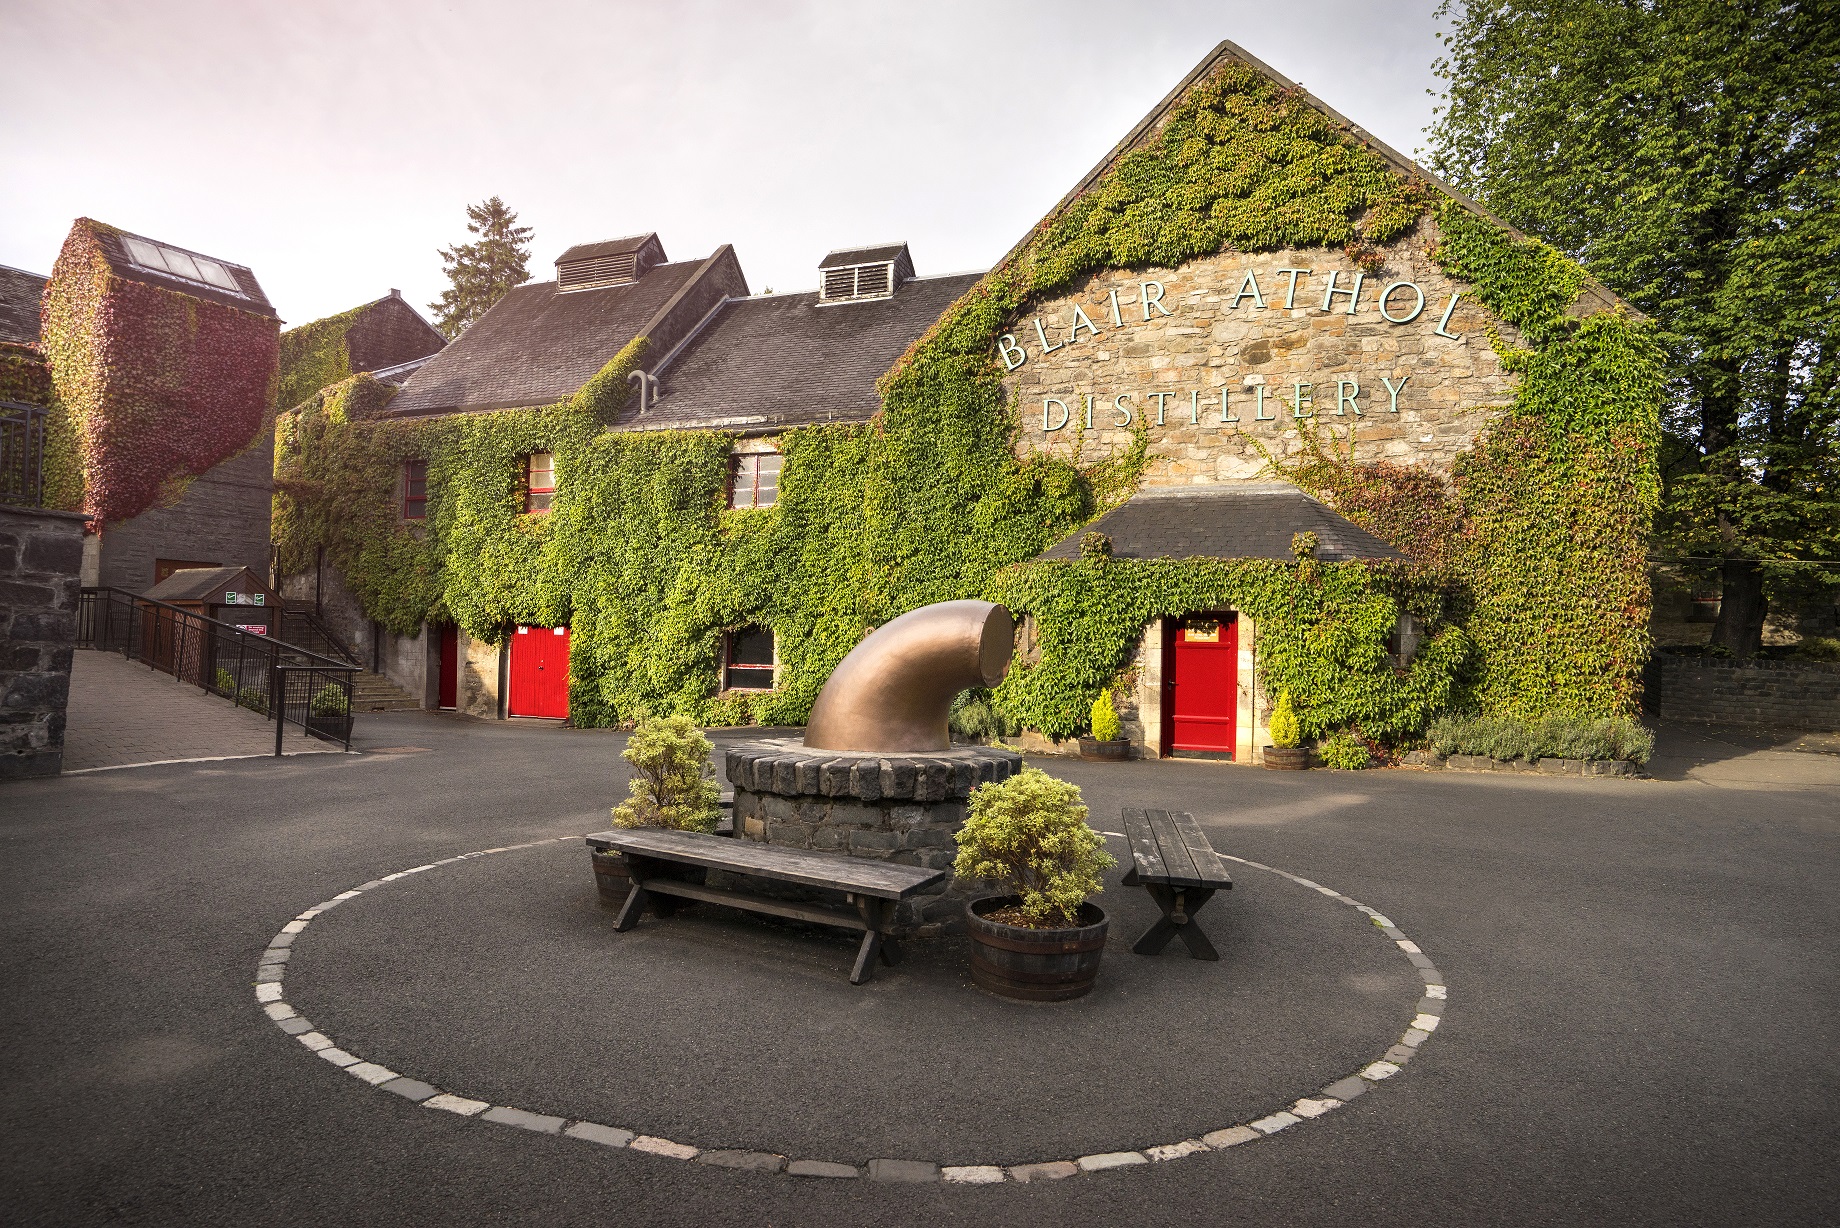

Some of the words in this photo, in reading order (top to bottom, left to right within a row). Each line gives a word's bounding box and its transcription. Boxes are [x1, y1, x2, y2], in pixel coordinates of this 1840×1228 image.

[998, 280, 1174, 372] BLAIR
[1229, 268, 1462, 341] ATHOL
[1042, 376, 1410, 432] DISTILLERY
